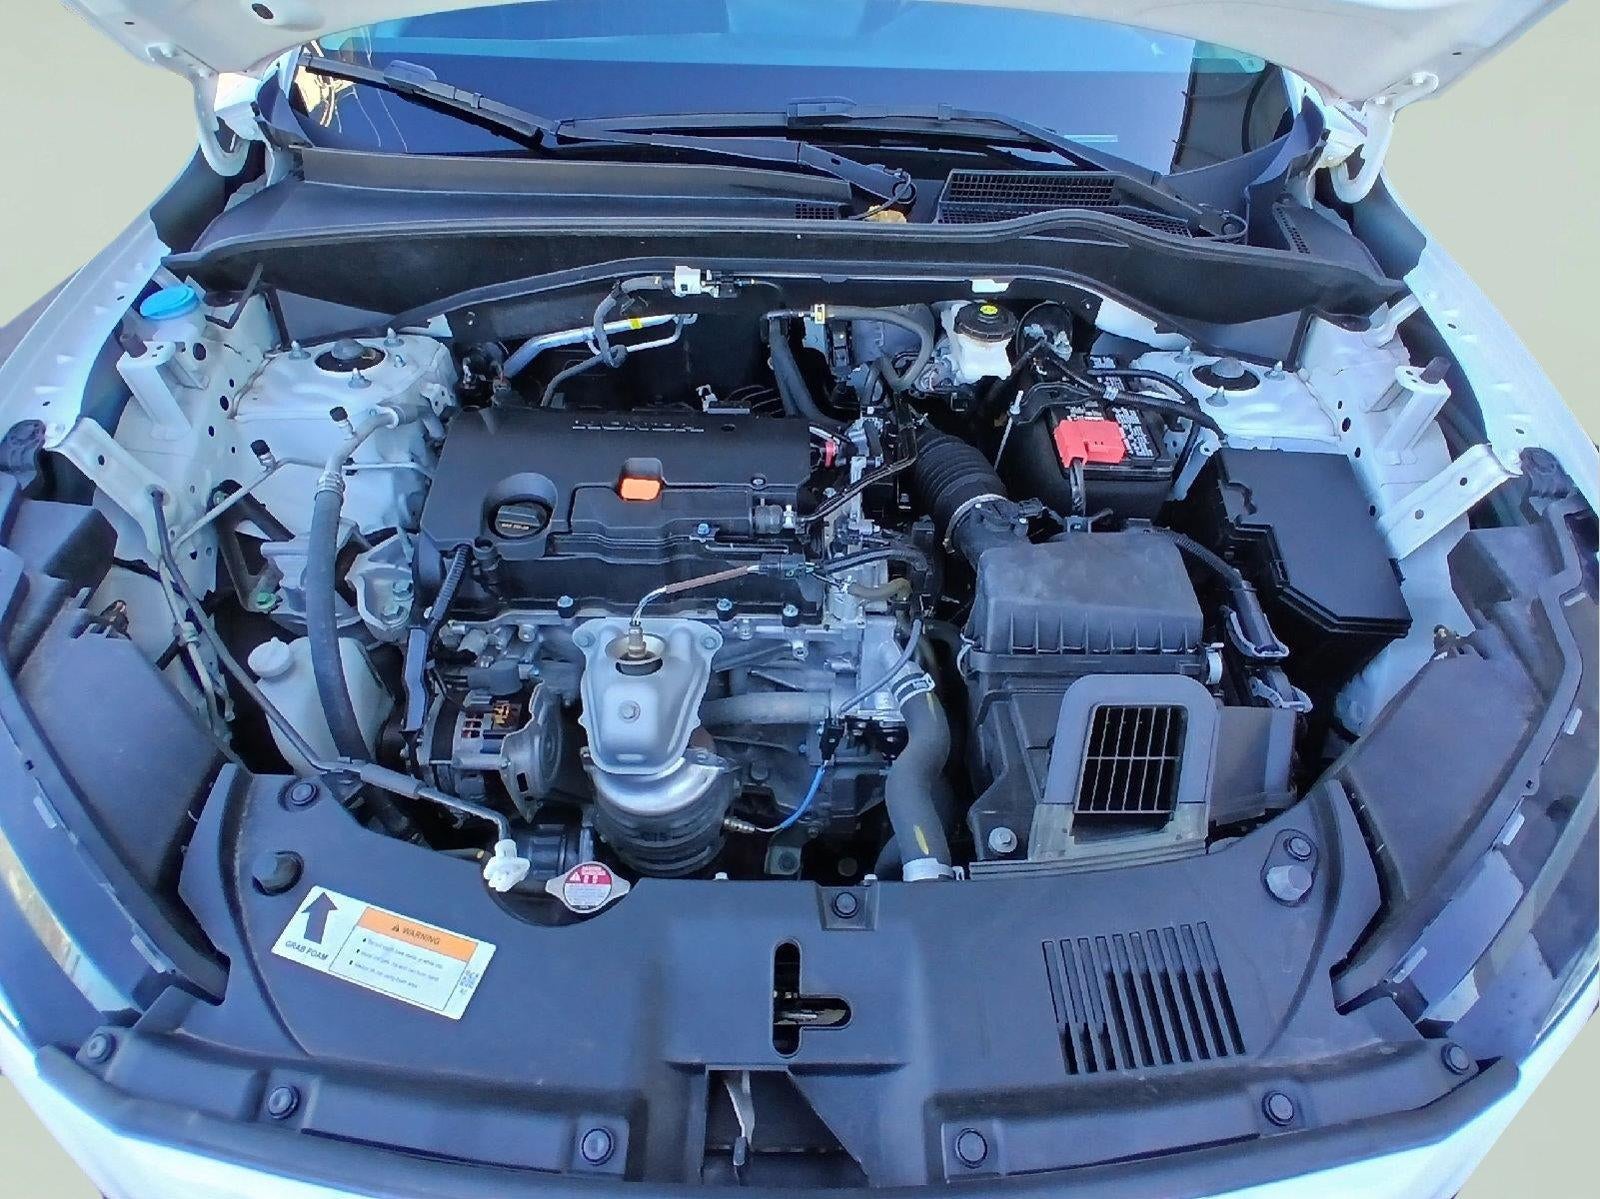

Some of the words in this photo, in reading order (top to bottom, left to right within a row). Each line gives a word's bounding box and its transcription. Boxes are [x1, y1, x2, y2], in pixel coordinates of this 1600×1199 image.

[402, 927, 441, 945] WARNING
[285, 940, 306, 953] GRAB
[306, 947, 328, 960] FOAM
